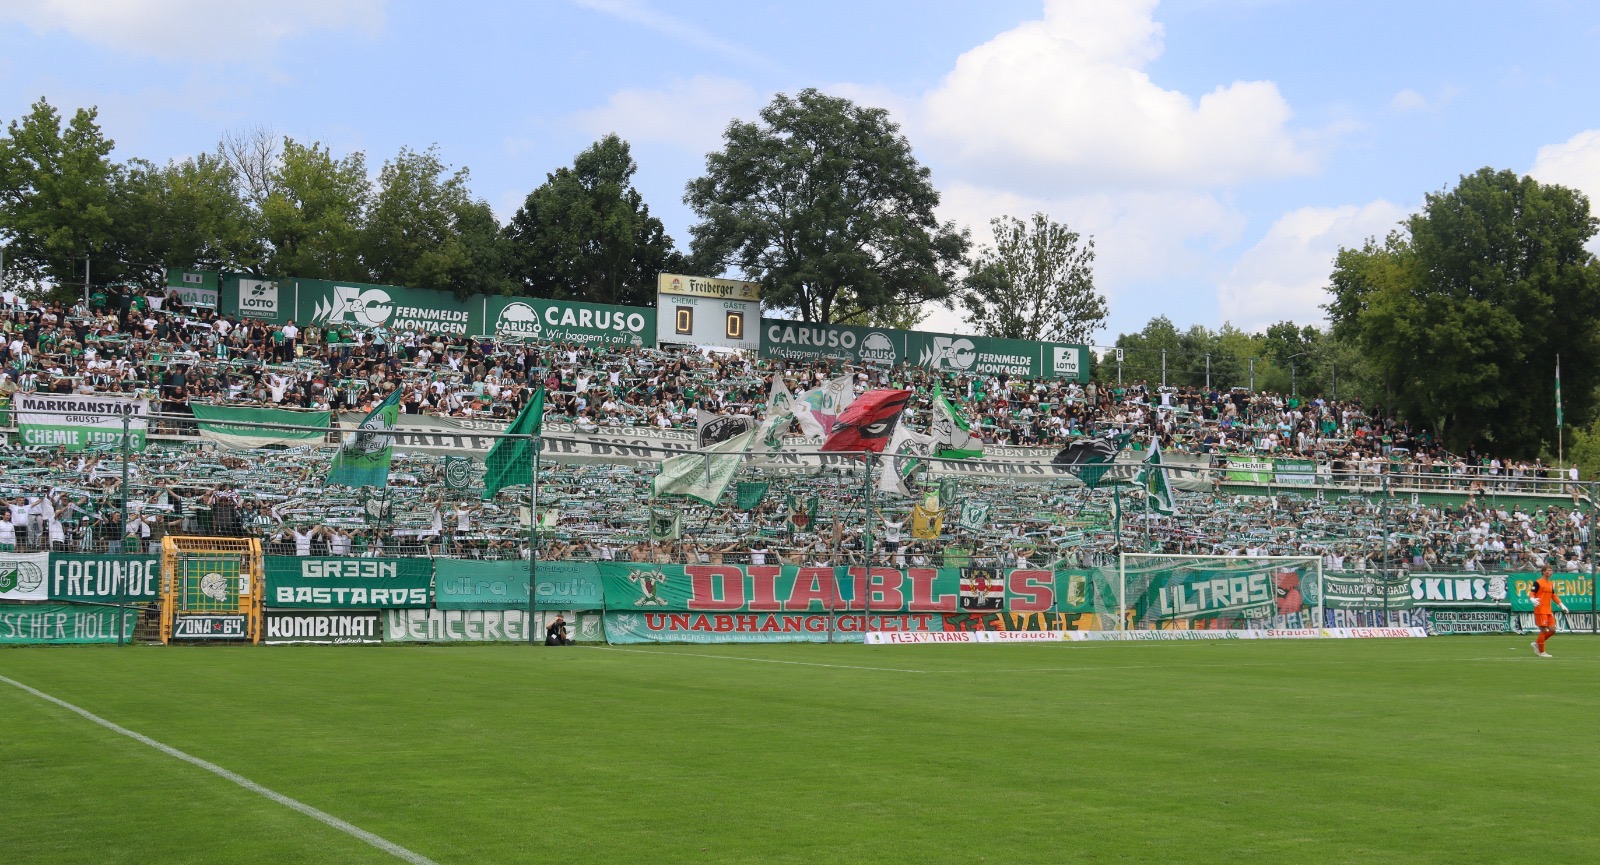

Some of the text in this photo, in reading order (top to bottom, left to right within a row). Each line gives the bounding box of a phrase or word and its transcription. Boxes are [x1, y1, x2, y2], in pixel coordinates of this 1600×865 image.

[689, 279, 734, 298] Freiberger
[243, 298, 274, 308] LOTTO
[671, 297, 699, 306] CHEMIE
[395, 306, 469, 323] FERNMELDE
[545, 306, 646, 332] CARUSO
[392, 318, 468, 334] MONTAGEN
[496, 321, 543, 333] CARUSO
[546, 328, 564, 340] Wir
[611, 334, 628, 346] an!
[768, 325, 857, 349] CARUSO
[858, 349, 897, 360] CARUSO
[978, 353, 1032, 368] FERNMELDE
[975, 365, 1031, 378] MONTAGEN
[1056, 362, 1077, 370] LOTTO
[22, 399, 141, 416] MARKRANSTÄDT
[26, 429, 141, 449] CHEMIE LEIPZG
[55, 559, 157, 596] FREUNDE
[276, 586, 427, 605] BASTARDS
[686, 564, 1056, 613] DIABLS
[1159, 573, 1270, 615] ULTRAS
[1411, 575, 1488, 602] SKINS
[1241, 606, 1271, 620] 1964
[1435, 612, 1508, 621] GEGEN REPRESSIONEN
[223, 619, 242, 635] 64
[267, 614, 377, 638] KOMBINAT
[645, 611, 933, 635] UNABHÄNGIGKEIT
[1436, 623, 1451, 631] UND
[930, 632, 970, 645] TRANS
[1380, 629, 1411, 640] TRANS
